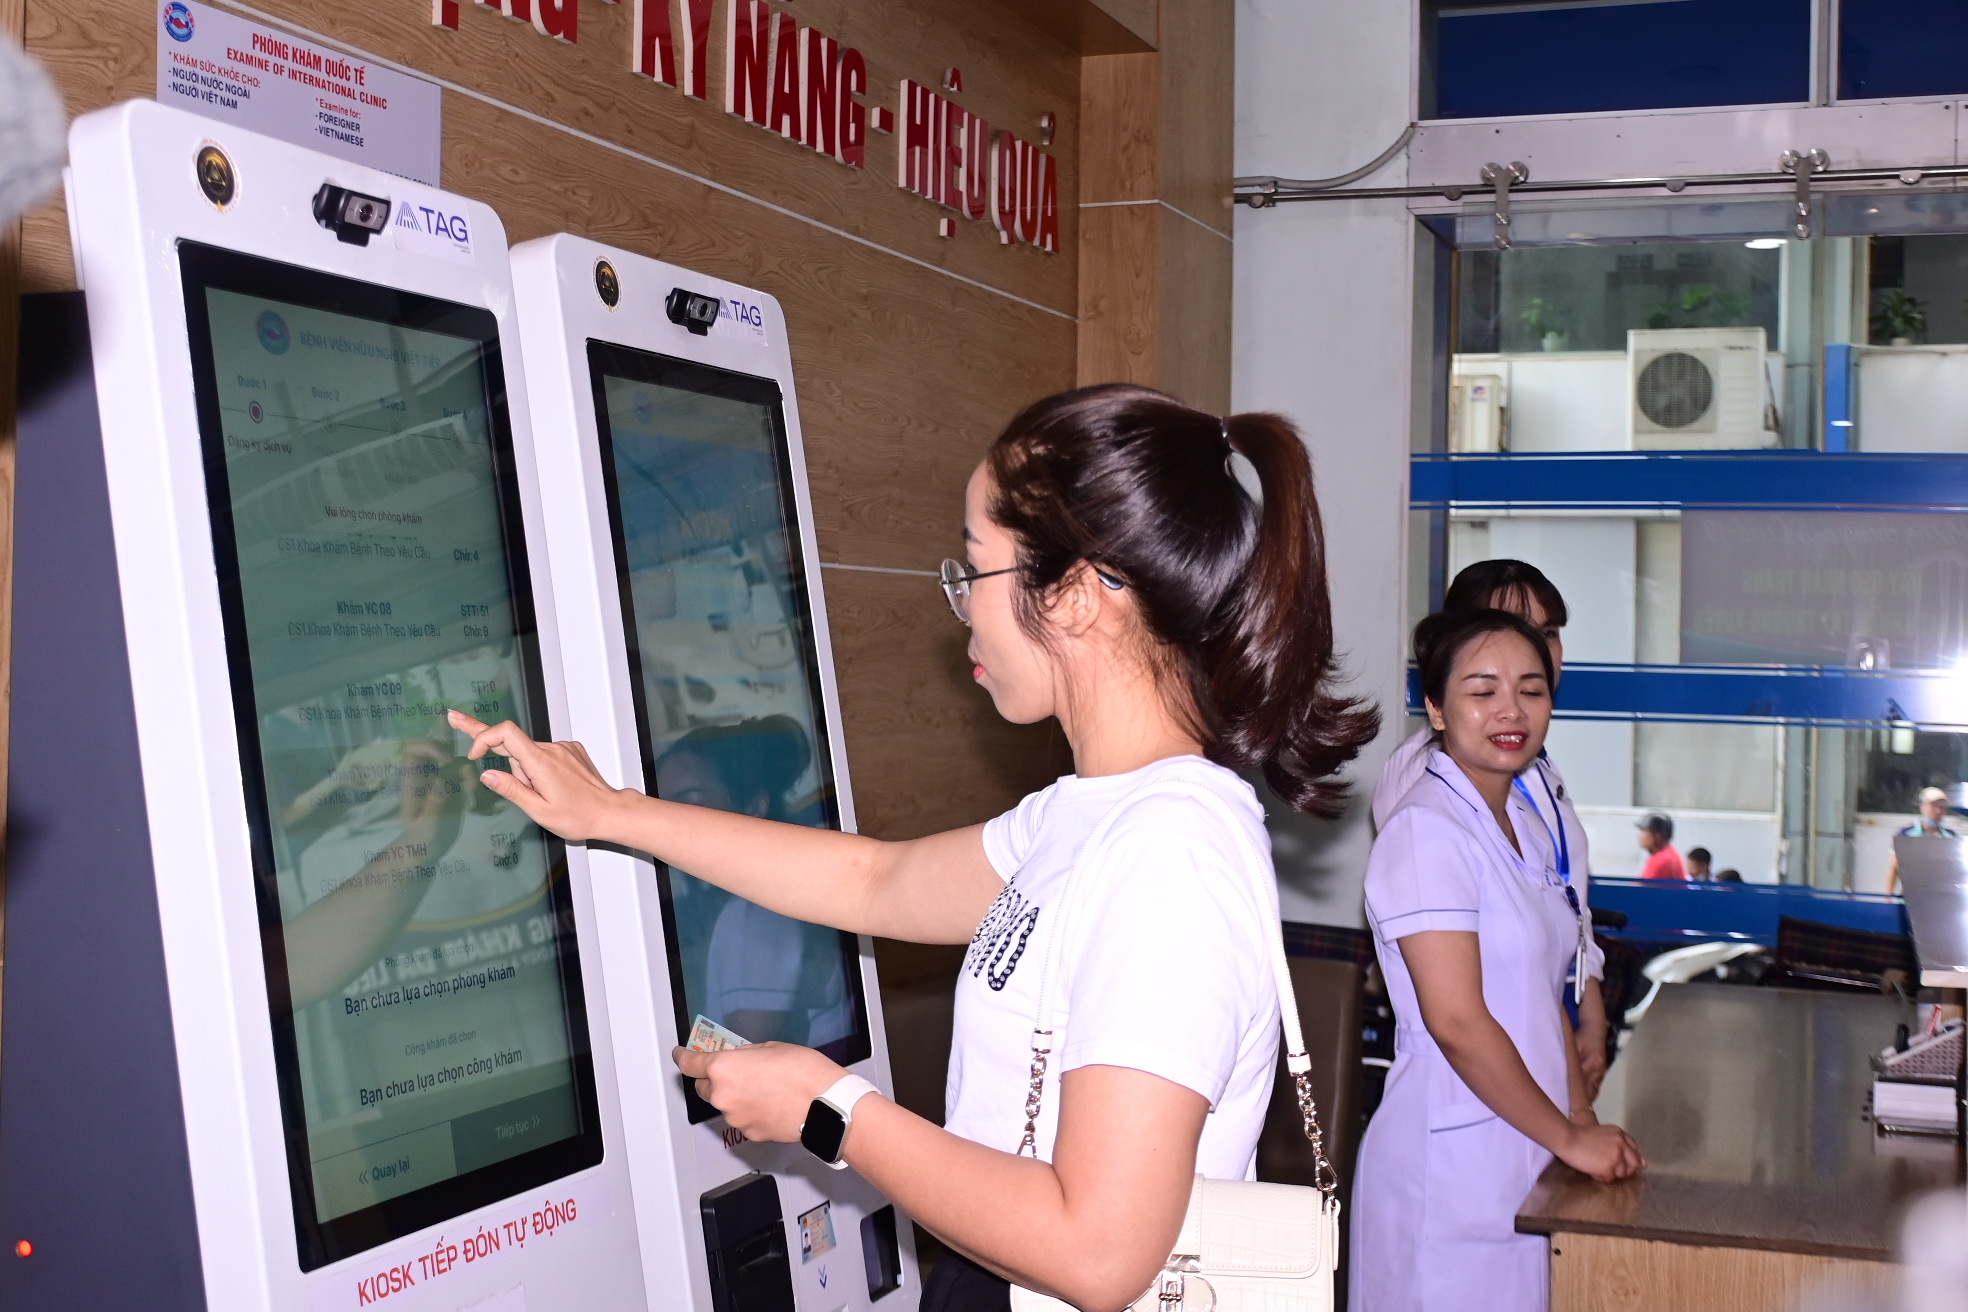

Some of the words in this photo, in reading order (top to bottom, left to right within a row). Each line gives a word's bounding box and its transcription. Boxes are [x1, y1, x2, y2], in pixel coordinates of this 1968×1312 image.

[174, 52, 198, 69] KHÁM
[241, 74, 261, 88] CHO:
[252, 33, 288, 60] PHÒNG
[292, 46, 322, 72] KHÁM
[325, 58, 350, 82] QUỐC
[354, 66, 365, 86] TẾ
[172, 66, 200, 84] NGƯỜI
[200, 76, 224, 92] NƯỚC
[225, 83, 250, 100] NGOÀI
[172, 82, 200, 98] NGƯỜI
[200, 89, 218, 104] VIỆT
[220, 96, 238, 110] NAM
[227, 48, 270, 72] EXAMINE
[273, 62, 285, 76] OF
[288, 68, 357, 100] INTERNATIONAL
[360, 91, 388, 110] CLINIC
[318, 112, 360, 132] FOREIGNER
[320, 98, 348, 116] Examine
[350, 108, 361, 120] for:
[318, 125, 364, 147] VIETNAMESE
[898, 68, 988, 238] HIỆU
[991, 111, 1060, 254] QUẢ
[418, 206, 469, 244] TAG
[730, 300, 762, 328] TAG
[334, 391, 340, 402] 2
[344, 996, 368, 1016] Bạn
[370, 990, 400, 1010] chưa
[402, 986, 420, 1005] lựa
[423, 978, 450, 998] chọn
[452, 971, 486, 996] phòng
[487, 964, 516, 983] khám
[360, 1088, 383, 1107] Bạn
[385, 1080, 414, 1098] chưa
[416, 1073, 435, 1092] lựa
[438, 1066, 464, 1084] chọn
[466, 1057, 494, 1076] công
[494, 1048, 522, 1068] khám
[372, 1164, 396, 1181] Quay
[357, 1261, 416, 1307] KIOSK
[418, 1236, 458, 1281] TIẾP
[463, 1226, 500, 1264] ĐÓN
[503, 1216, 528, 1248] TỰ
[532, 1198, 578, 1236] ĐỘNG
